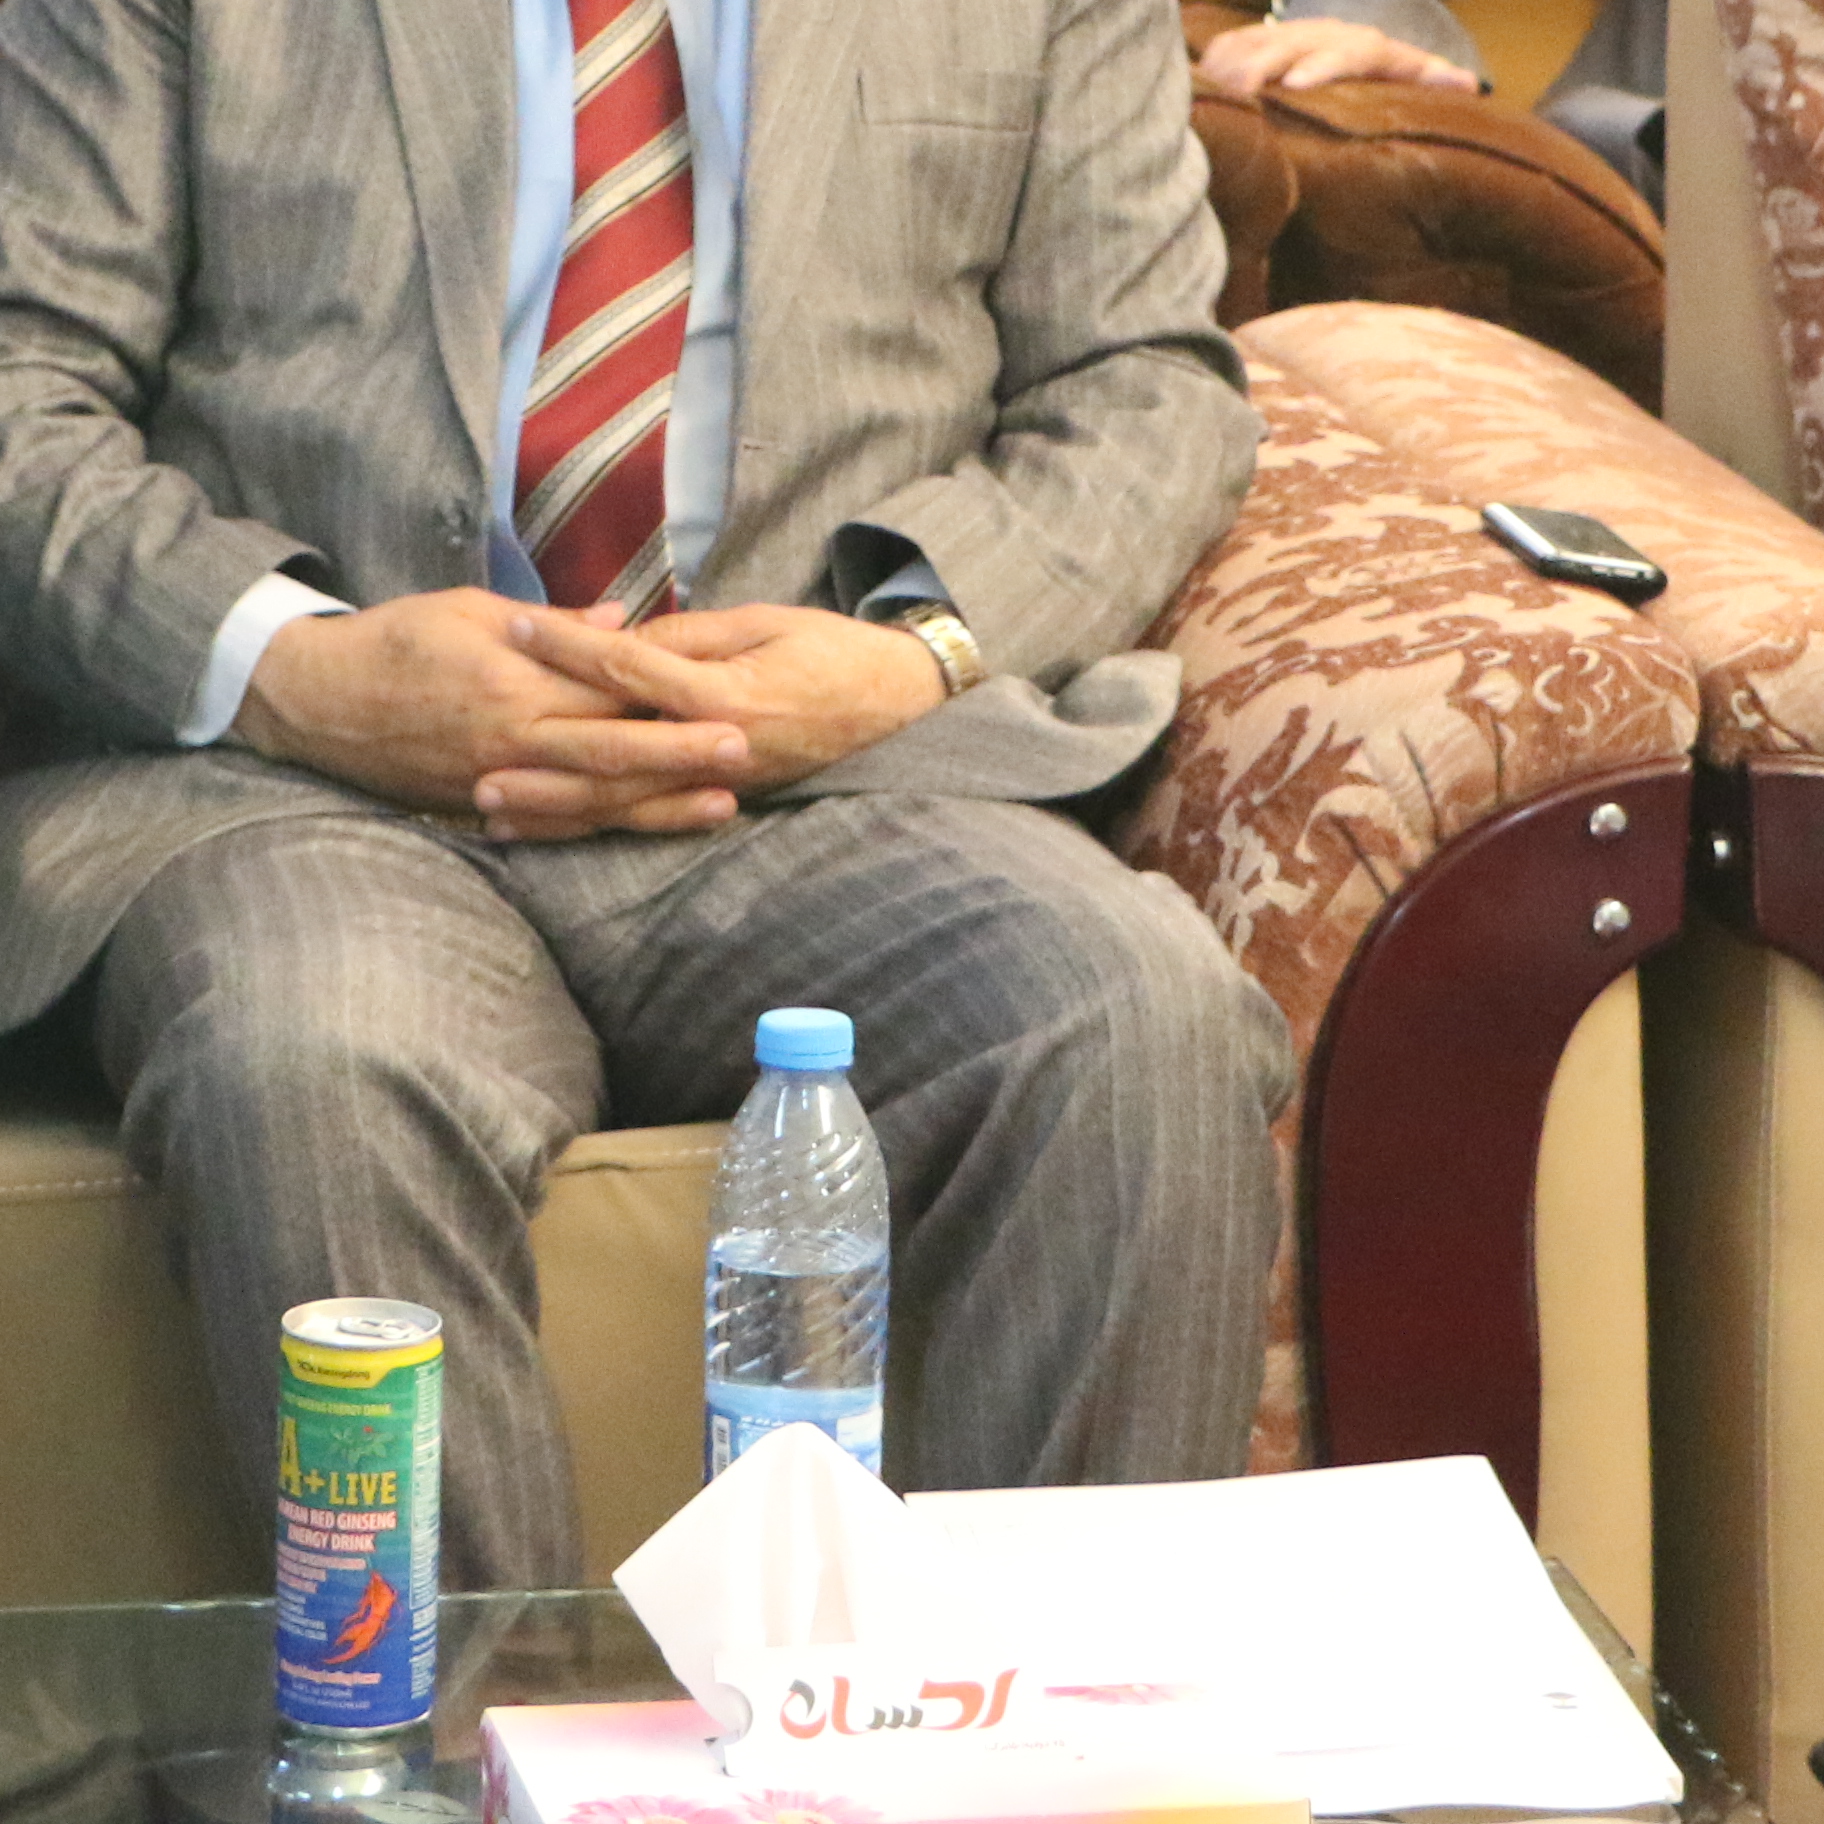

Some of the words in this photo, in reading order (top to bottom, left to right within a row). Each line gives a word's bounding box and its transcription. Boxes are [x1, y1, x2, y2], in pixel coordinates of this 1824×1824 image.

[309, 1508, 336, 1528] RED
[336, 1510, 398, 1531] GINSENG
[330, 1533, 377, 1553] DRINK
[779, 1667, 1020, 1740] احسان
